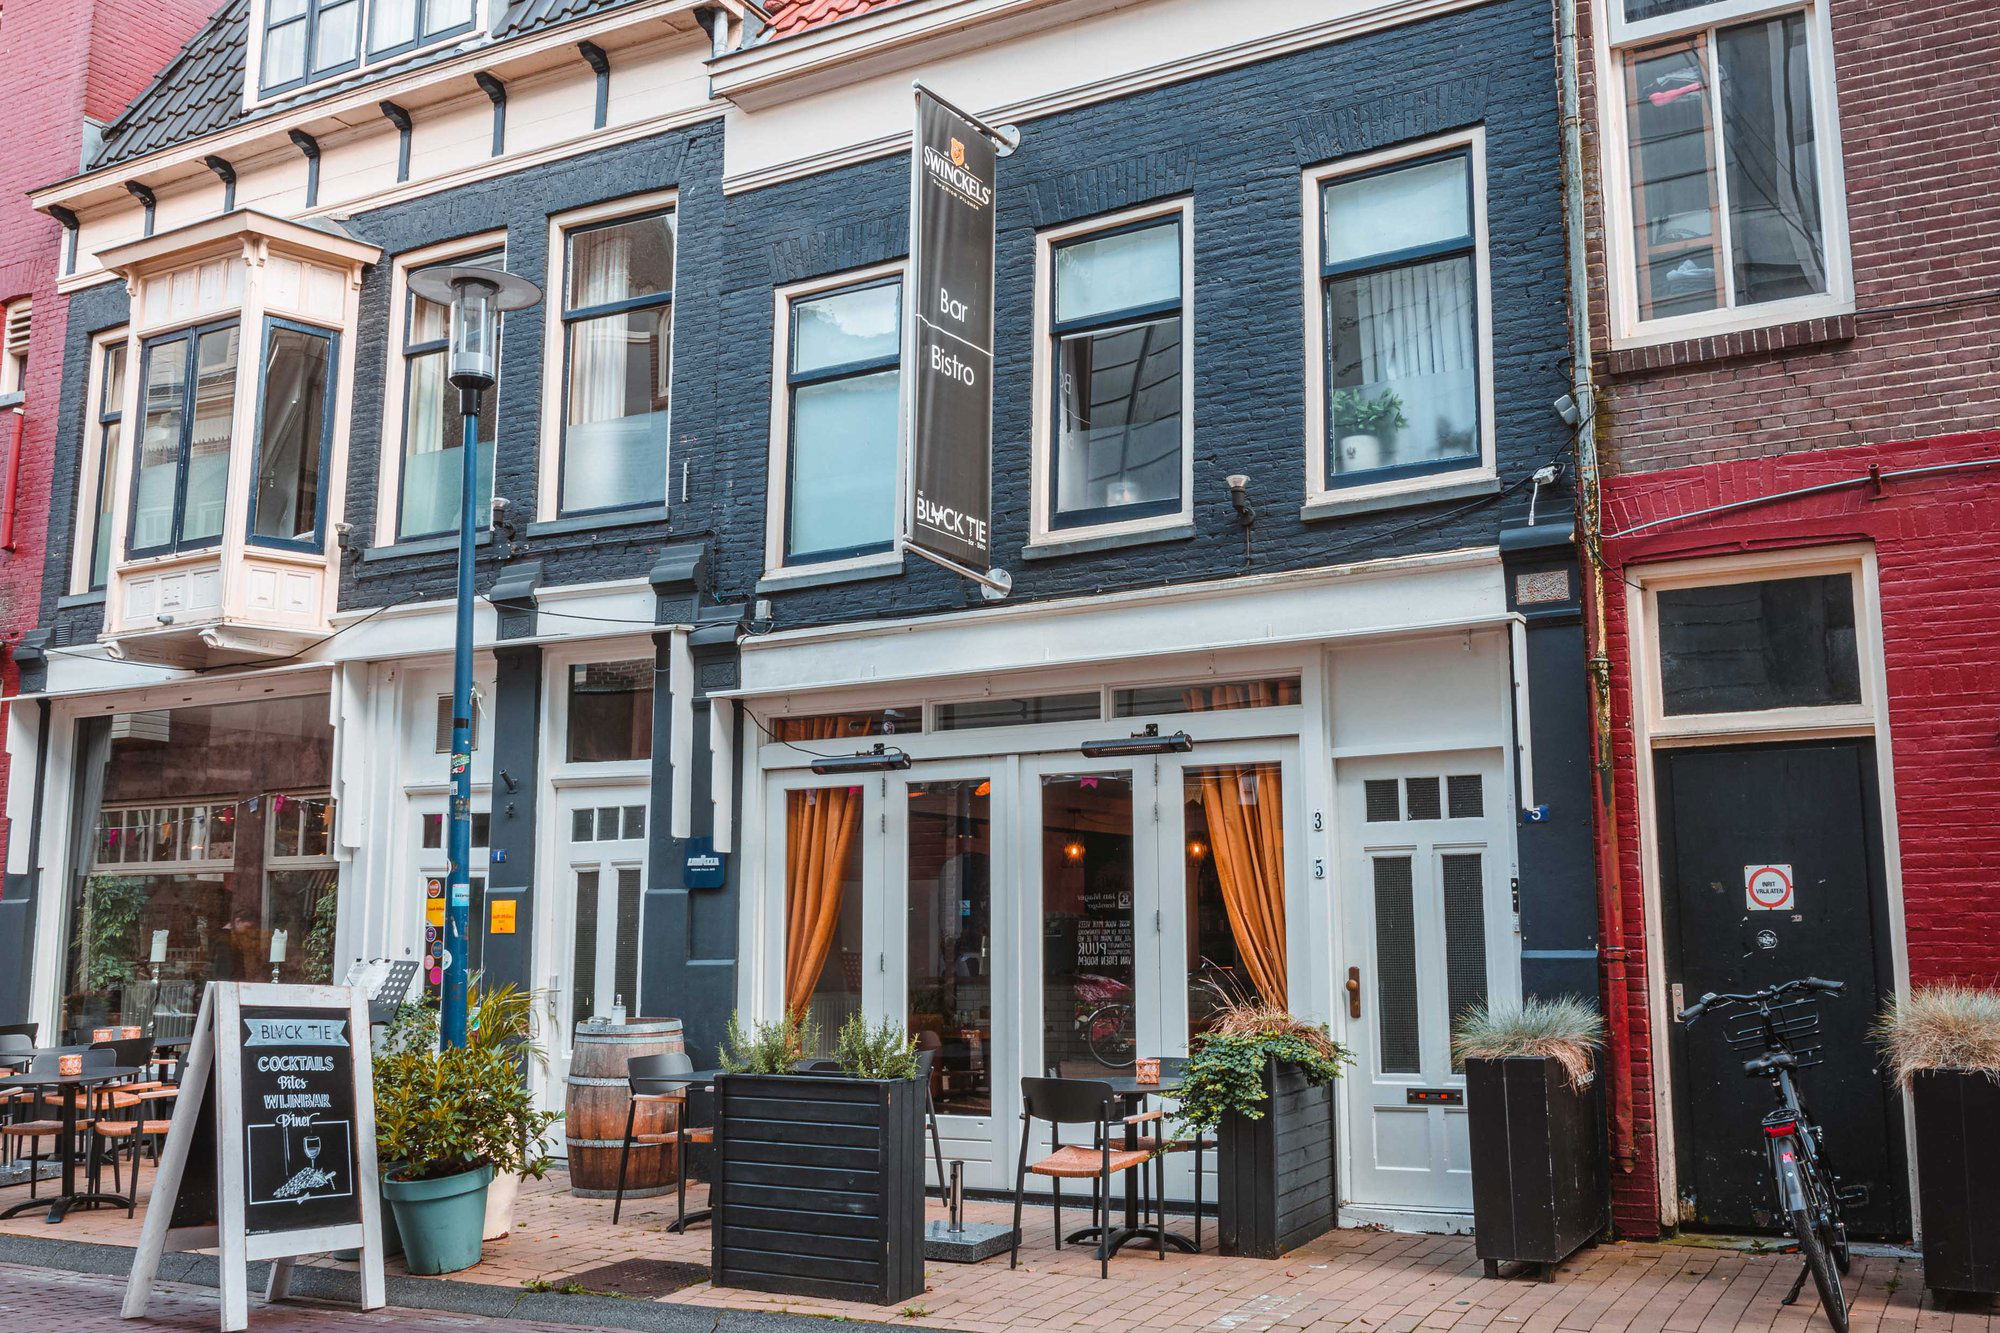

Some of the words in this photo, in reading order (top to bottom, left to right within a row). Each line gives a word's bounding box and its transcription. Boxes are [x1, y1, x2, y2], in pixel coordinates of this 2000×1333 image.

[940, 287, 969, 323] Bar
[931, 344, 975, 386] Bistro
[965, 515, 987, 544] TIE
[1314, 812, 1322, 829] 3
[1531, 807, 1541, 820] 5
[1315, 859, 1324, 877] 5
[307, 1024, 332, 1040] TIE
[257, 1055, 335, 1072] COCKTAILS
[277, 1075, 309, 1090] Bites
[263, 1093, 332, 1110] WIJNBAR
[275, 1111, 321, 1128] Diner
